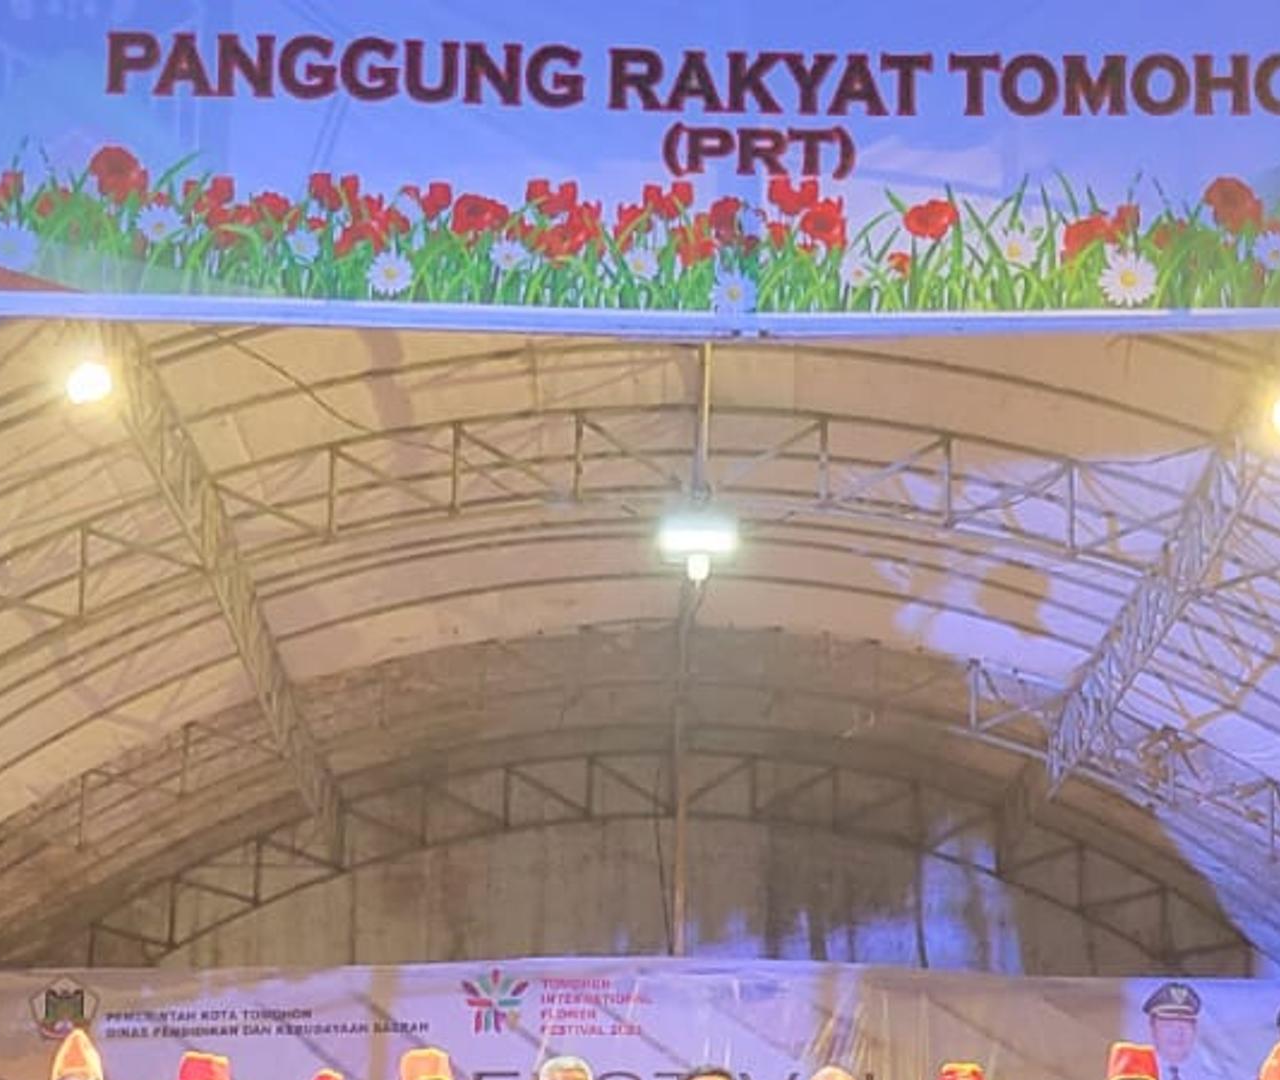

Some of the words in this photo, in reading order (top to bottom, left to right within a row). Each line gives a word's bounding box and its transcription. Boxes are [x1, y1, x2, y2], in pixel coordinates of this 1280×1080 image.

[106, 29, 584, 108] PANGGUNG
[606, 49, 934, 117] RAKYAT
[661, 123, 855, 182] (PRT)
[105, 1010, 197, 1022] PEMERINTAH
[200, 1009, 238, 1021] KOTA
[242, 1008, 313, 1021] TOMOHON
[242, 1024, 271, 1036] DAN
[541, 1024, 604, 1036] FESTIVAL
